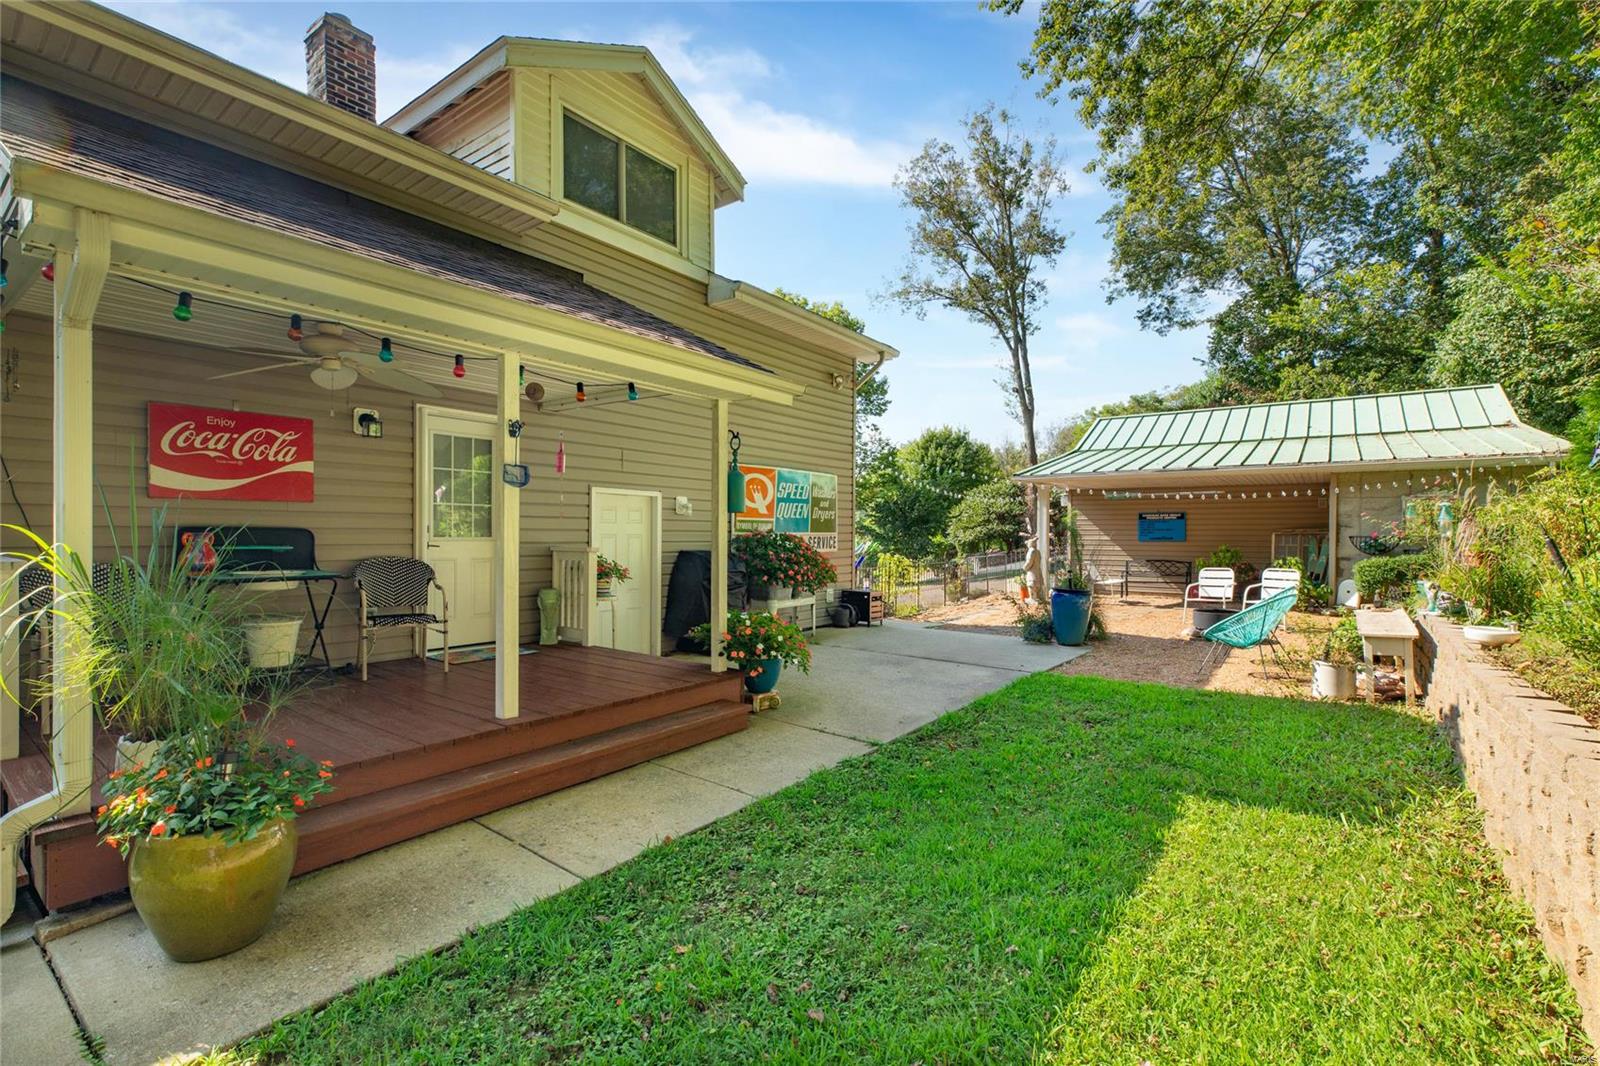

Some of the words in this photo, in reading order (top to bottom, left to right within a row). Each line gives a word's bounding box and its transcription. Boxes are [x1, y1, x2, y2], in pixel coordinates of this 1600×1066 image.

[206, 415, 236, 428] Enjoy
[160, 421, 303, 463] Coca-Cola
[777, 482, 809, 500] SPEED
[776, 502, 808, 520] QUEEN
[812, 507, 835, 522] Dryers
